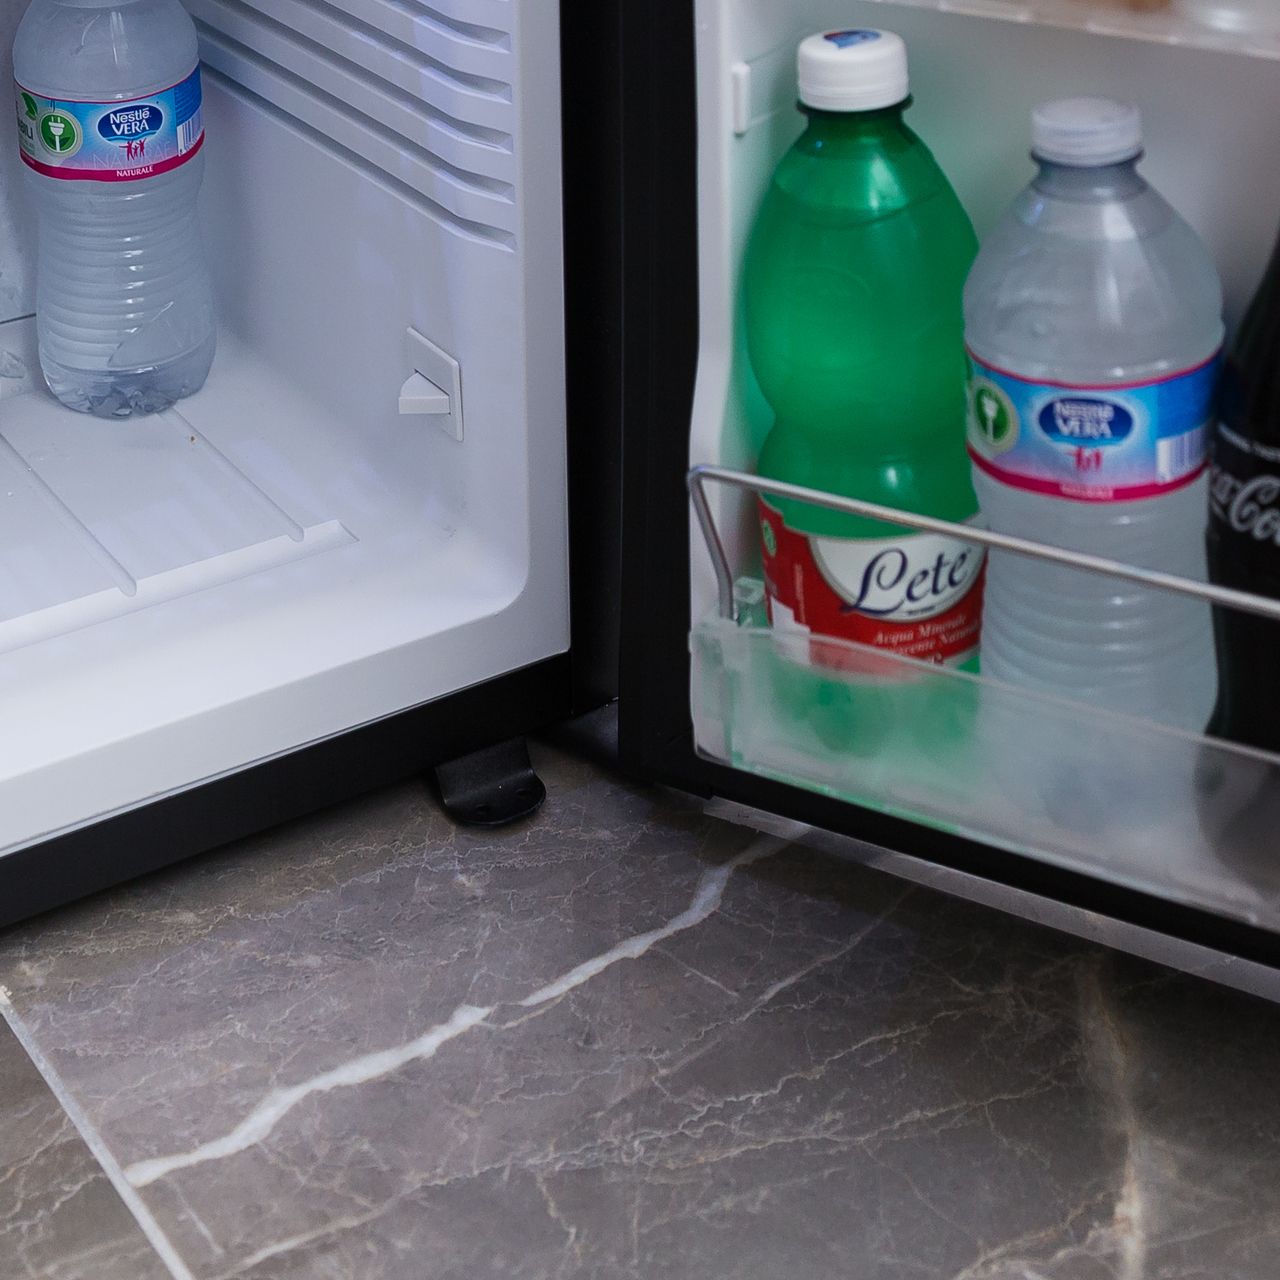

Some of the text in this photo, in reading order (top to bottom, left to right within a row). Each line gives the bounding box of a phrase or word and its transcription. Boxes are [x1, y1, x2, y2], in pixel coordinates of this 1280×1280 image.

[109, 107, 151, 125] Nestlé
[111, 119, 150, 136] VERA
[116, 165, 154, 177] NATURALE
[839, 547, 968, 616] Lete
